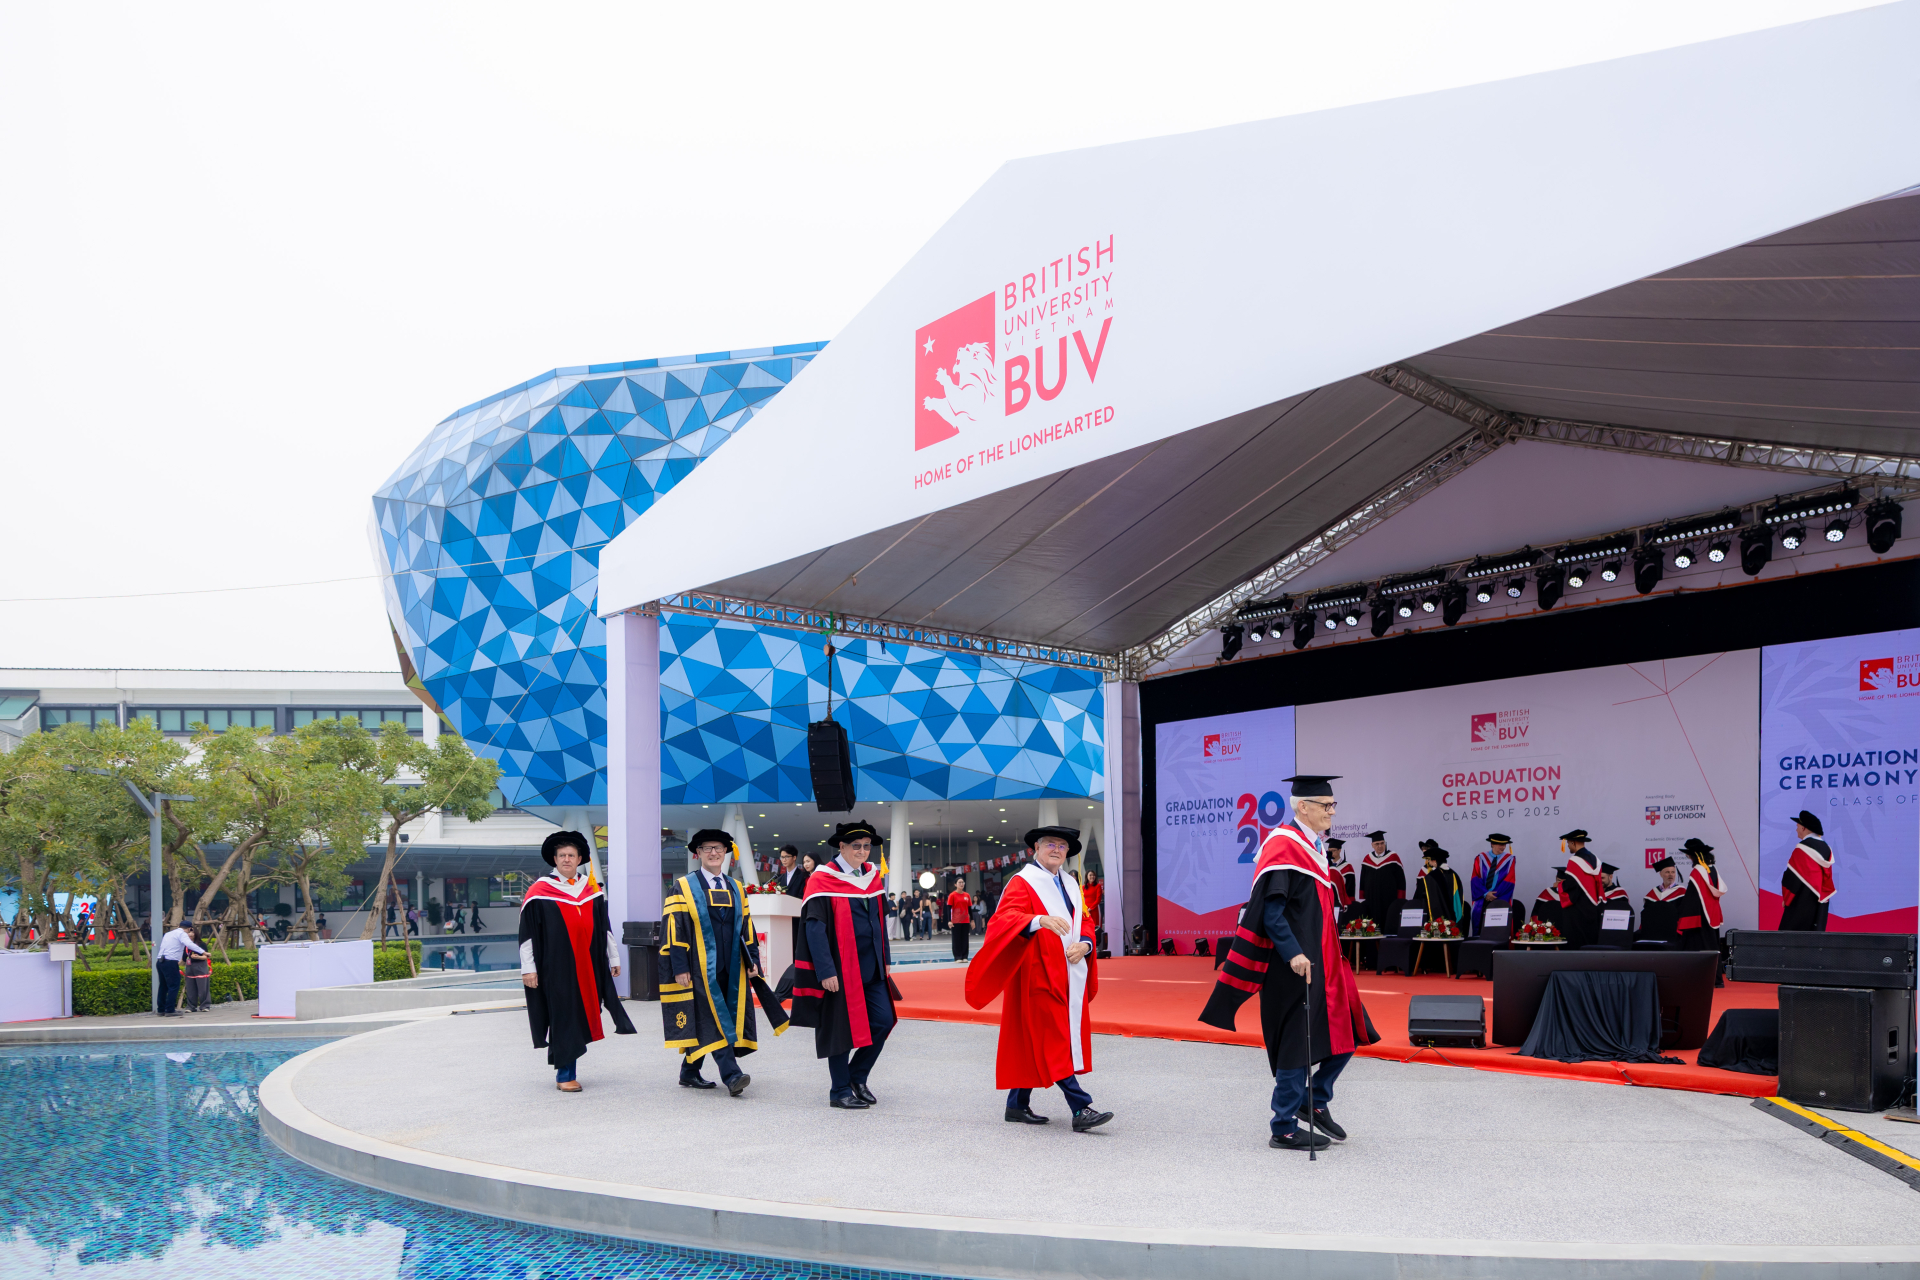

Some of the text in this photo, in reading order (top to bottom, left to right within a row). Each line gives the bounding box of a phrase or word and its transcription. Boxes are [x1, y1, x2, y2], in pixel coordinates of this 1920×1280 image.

[1004, 234, 1114, 311] BRITISH
[1004, 272, 1113, 335] UNIVERSITY
[1004, 297, 1114, 351] VIETNAM
[1005, 316, 1113, 416] BUV
[914, 405, 1115, 489] HOME OF THE LIONHEARTED
[1897, 672, 1920, 688] BU
[1499, 709, 1529, 718] BRITISH
[1499, 725, 1529, 740] BUV
[1222, 744, 1241, 755] BUV
[1779, 749, 1918, 771] GRADUATION
[1442, 765, 1561, 788] GRADUATION
[1779, 769, 1918, 790] CEREMONY
[1166, 797, 1233, 812] GRADUATION
[1442, 785, 1561, 807] CEREMONY
[1830, 794, 1918, 807] CLASS OF
[1237, 791, 1285, 830] 20
[1443, 806, 1560, 821] CLASS OF 2025
[1664, 804, 1704, 812] UNIVERSITY
[1166, 811, 1233, 826] CEREMONY
[1191, 828, 1234, 838] CLASS OF
